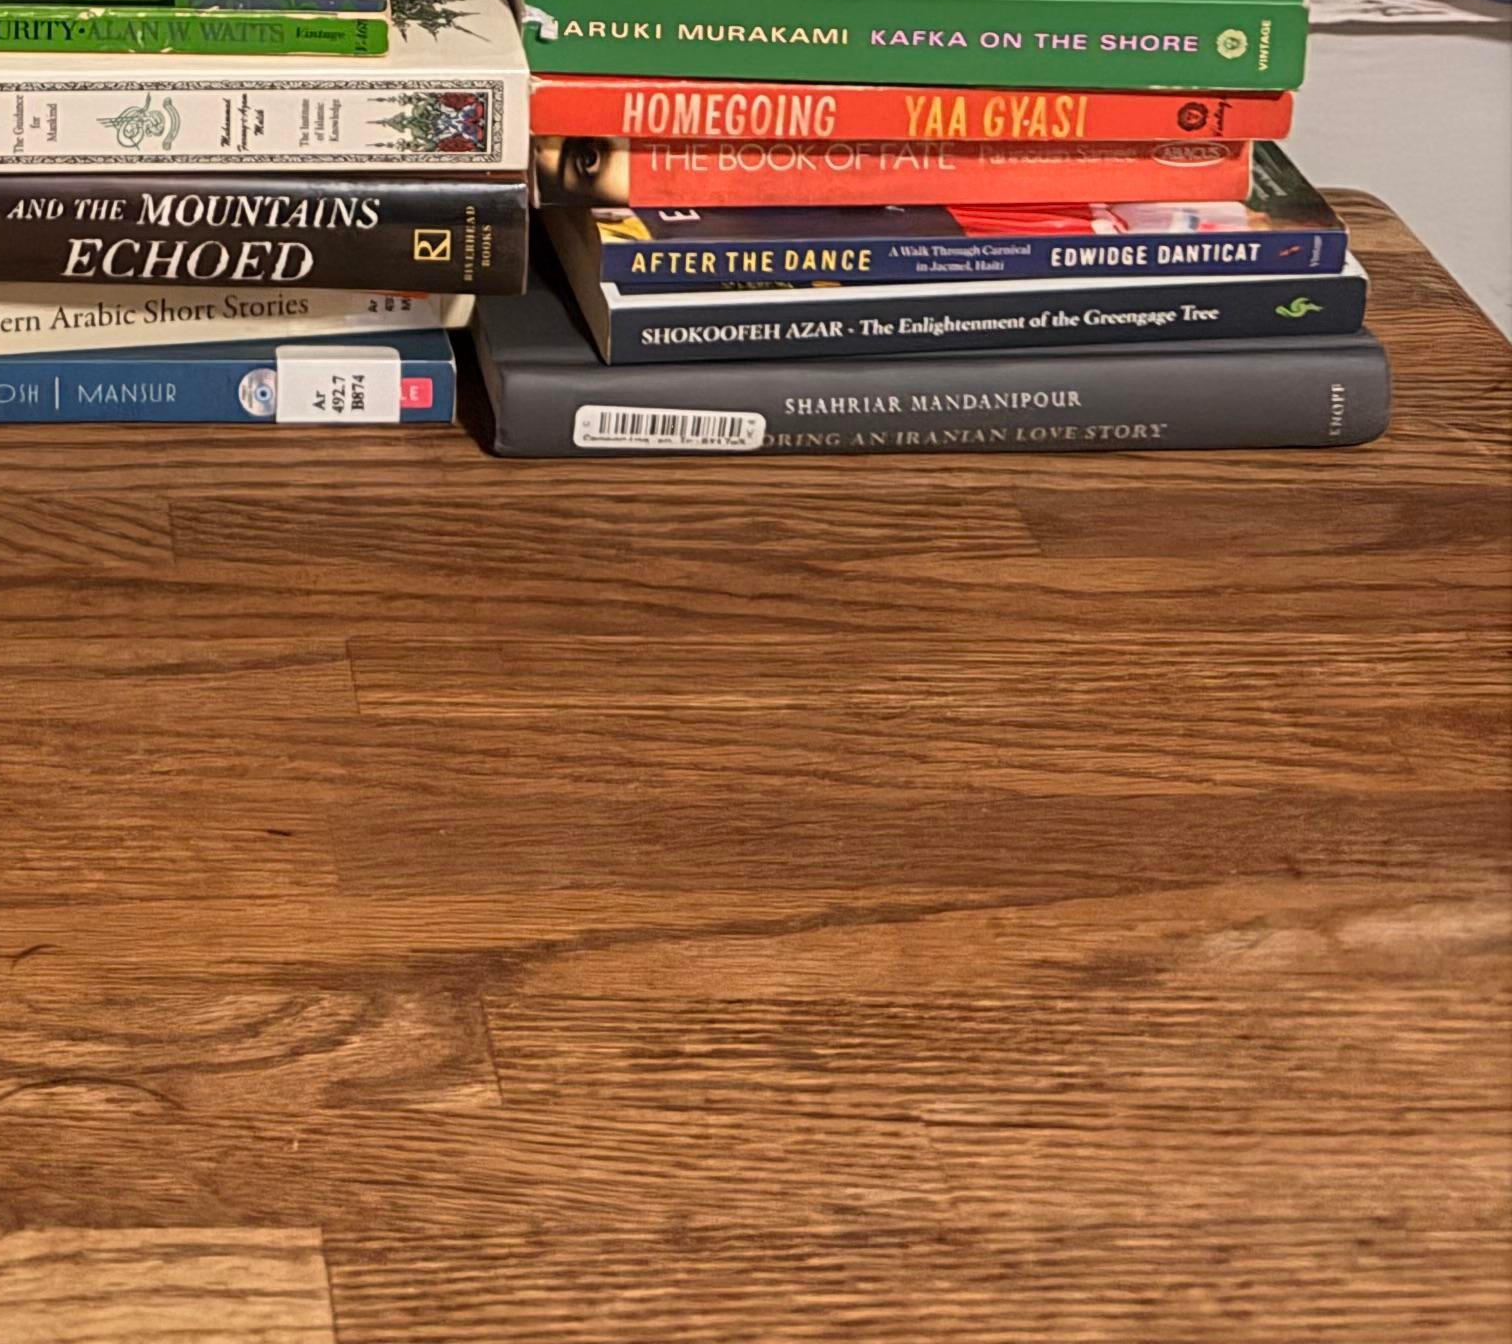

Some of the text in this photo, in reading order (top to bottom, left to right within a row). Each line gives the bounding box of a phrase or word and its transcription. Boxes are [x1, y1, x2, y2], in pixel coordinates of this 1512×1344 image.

[872, 31, 1197, 51] KAFKA ON THE SHORE
[1259, 21, 1271, 70] VINTAGE
[642, 322, 843, 344] SHOKOOFEH AZAR
[332, 376, 345, 413] 492.7
[351, 375, 364, 410] B874
[786, 391, 1081, 414] SHAHRIAR MANDANIPOUR
